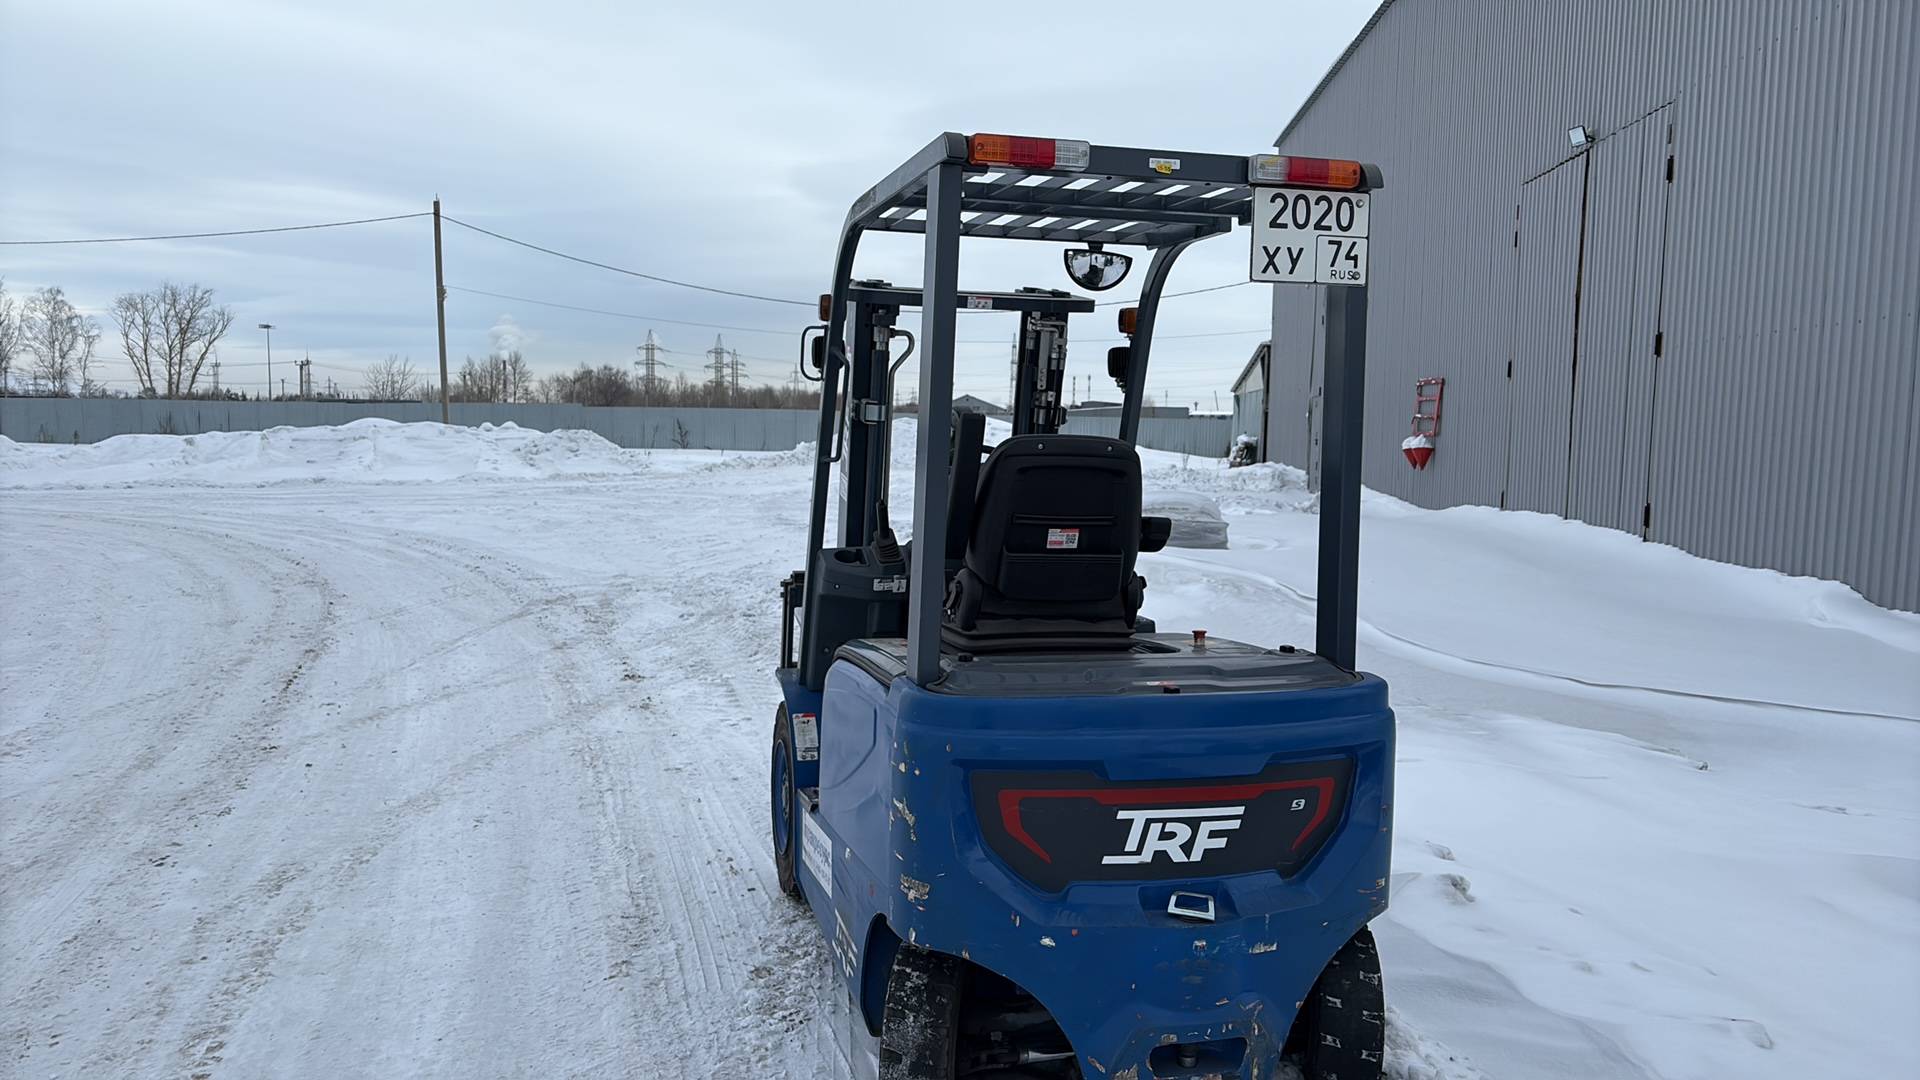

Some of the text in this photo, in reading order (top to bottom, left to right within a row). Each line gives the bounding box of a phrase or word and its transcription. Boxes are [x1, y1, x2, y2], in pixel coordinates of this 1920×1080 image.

[1269, 192, 1355, 232] 2020
[1328, 240, 1359, 269] 74
[1330, 269, 1354, 280] RUS
[1101, 806, 1245, 864] TRF
